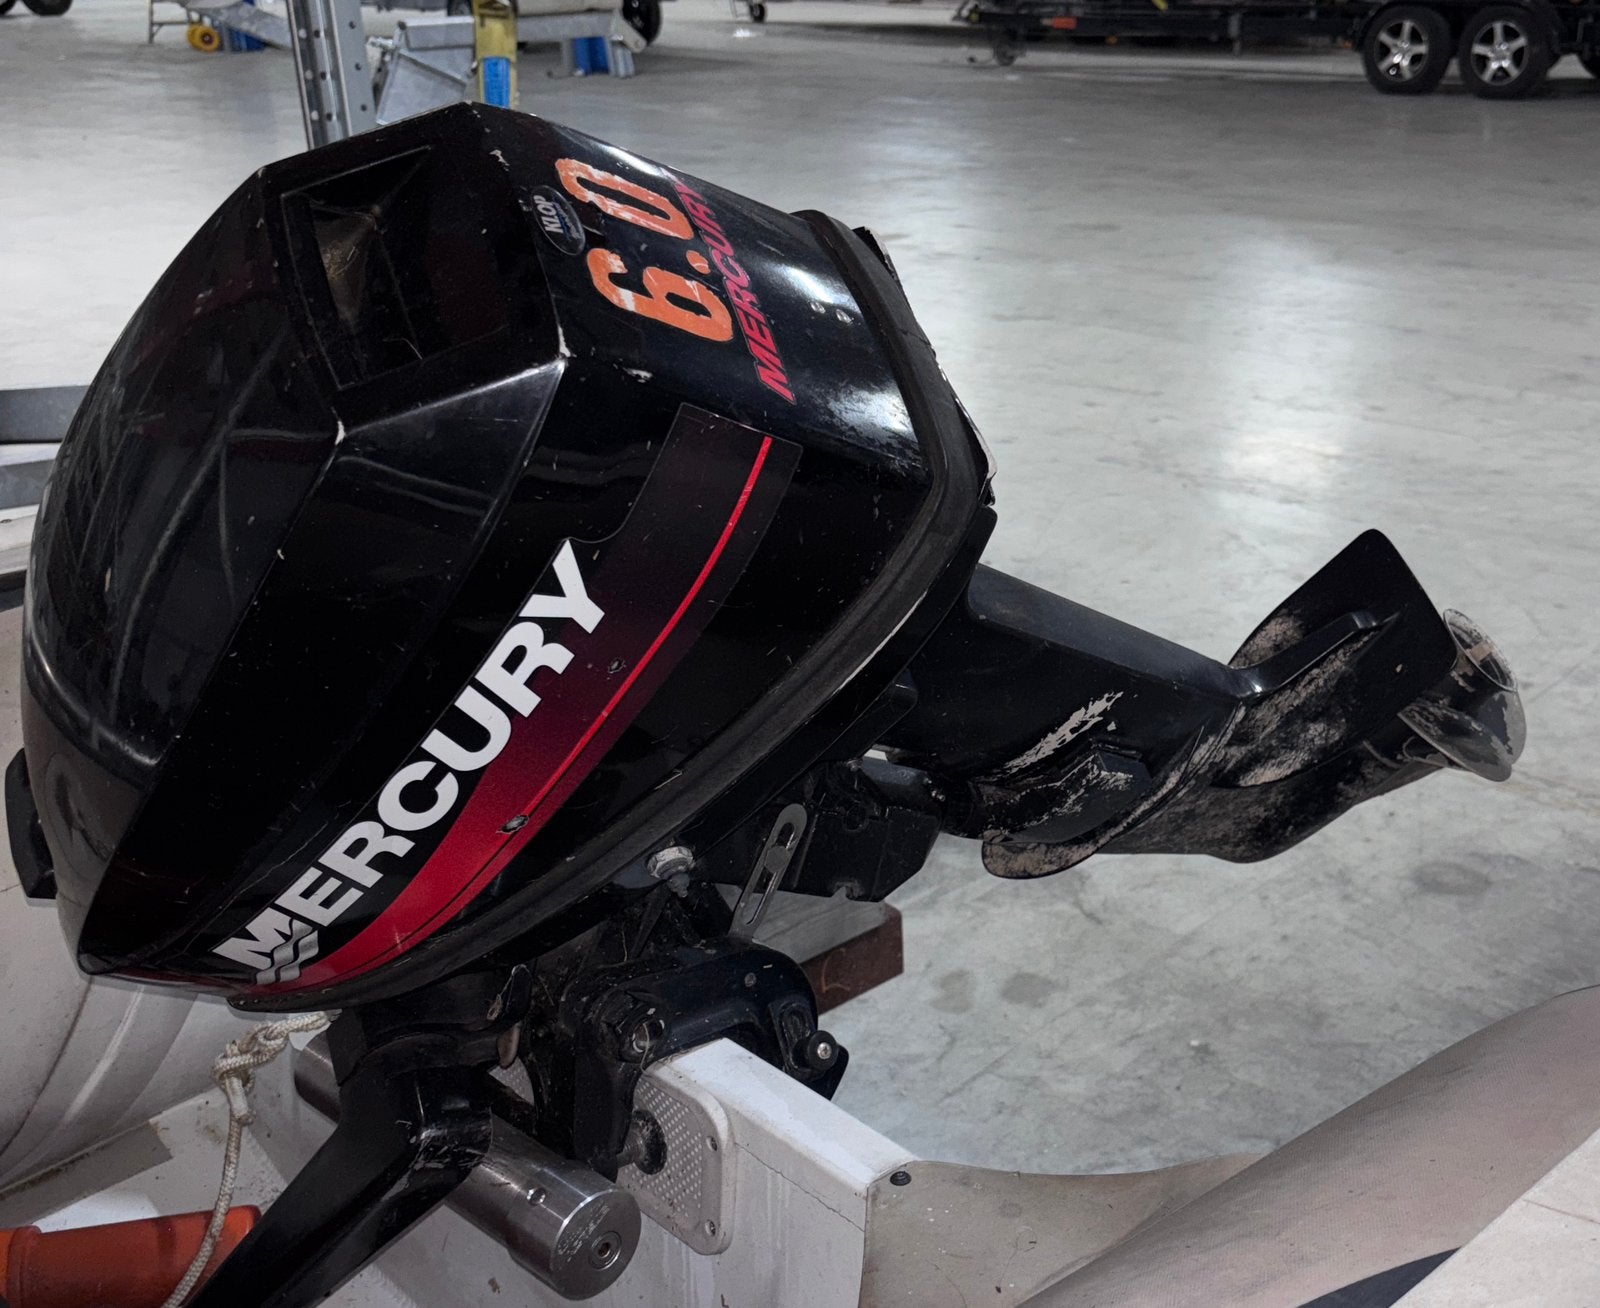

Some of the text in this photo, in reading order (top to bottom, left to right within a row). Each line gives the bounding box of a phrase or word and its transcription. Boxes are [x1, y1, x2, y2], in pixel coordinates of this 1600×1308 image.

[555, 158, 734, 342] 6.0
[660, 167, 796, 403] MERCURY
[212, 539, 605, 984] MERCURY
